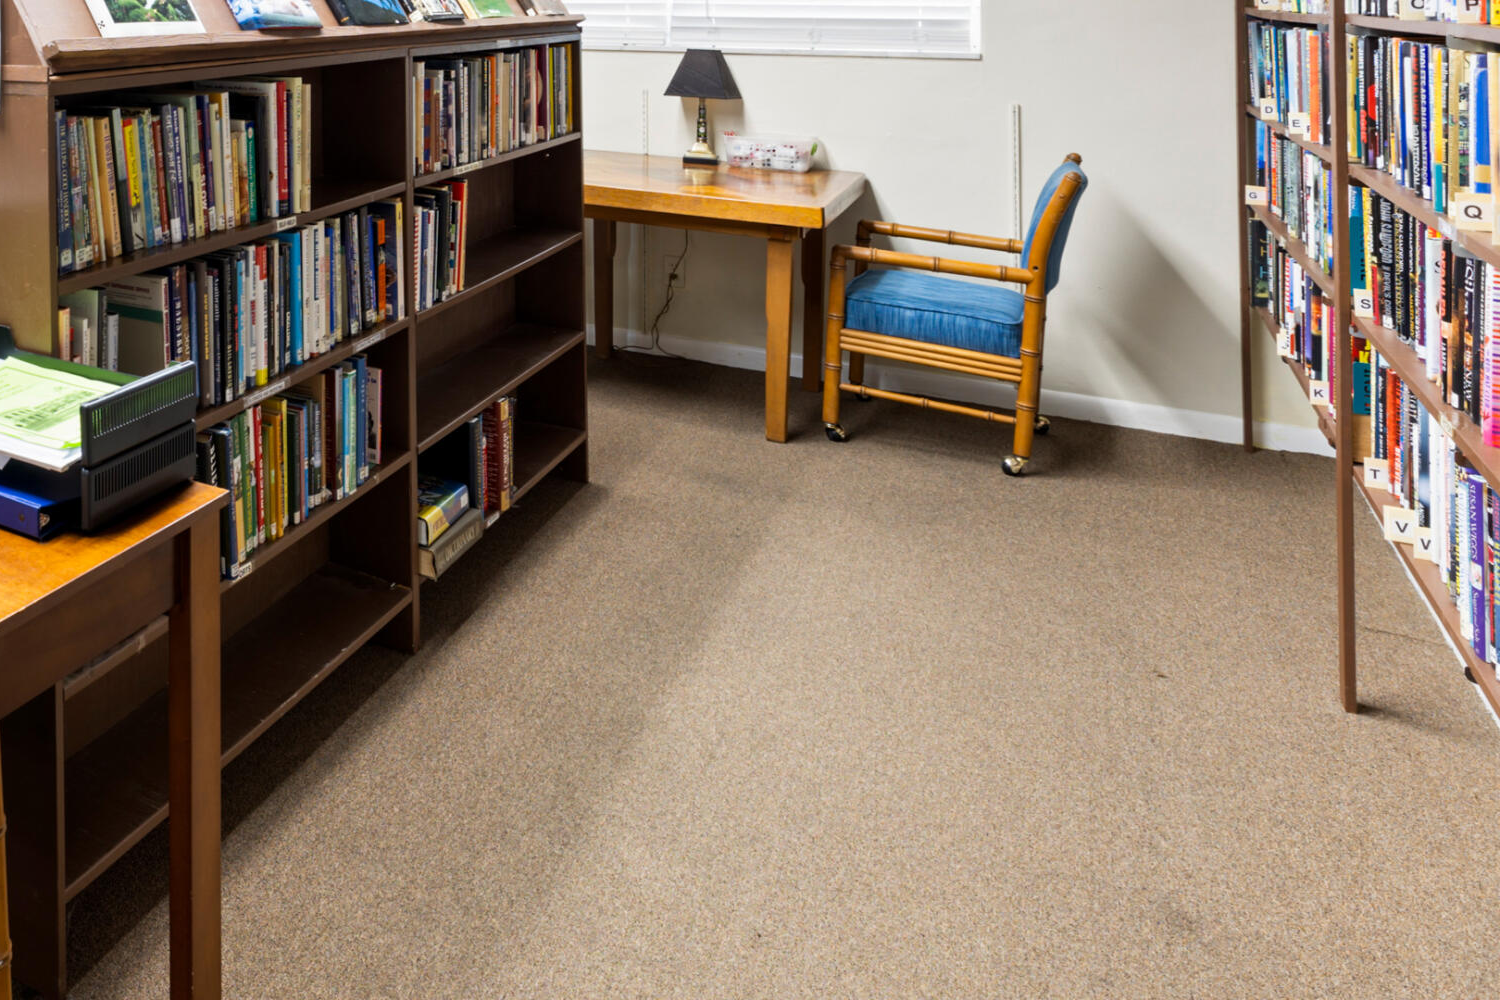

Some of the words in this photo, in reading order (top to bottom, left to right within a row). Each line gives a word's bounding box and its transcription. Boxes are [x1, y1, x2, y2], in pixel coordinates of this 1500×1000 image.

[1380, 201, 1391, 222] JOHN
[1464, 205, 1483, 220] Q
[1380, 223, 1392, 264] SANDFORD
[1361, 299, 1371, 308] S
[1315, 389, 1324, 398] K
[1370, 468, 1379, 479] T
[1469, 484, 1478, 518] SUSAN
[1395, 521, 1408, 533] V
[1421, 538, 1431, 550] V
[1470, 522, 1478, 560] WIGGS
